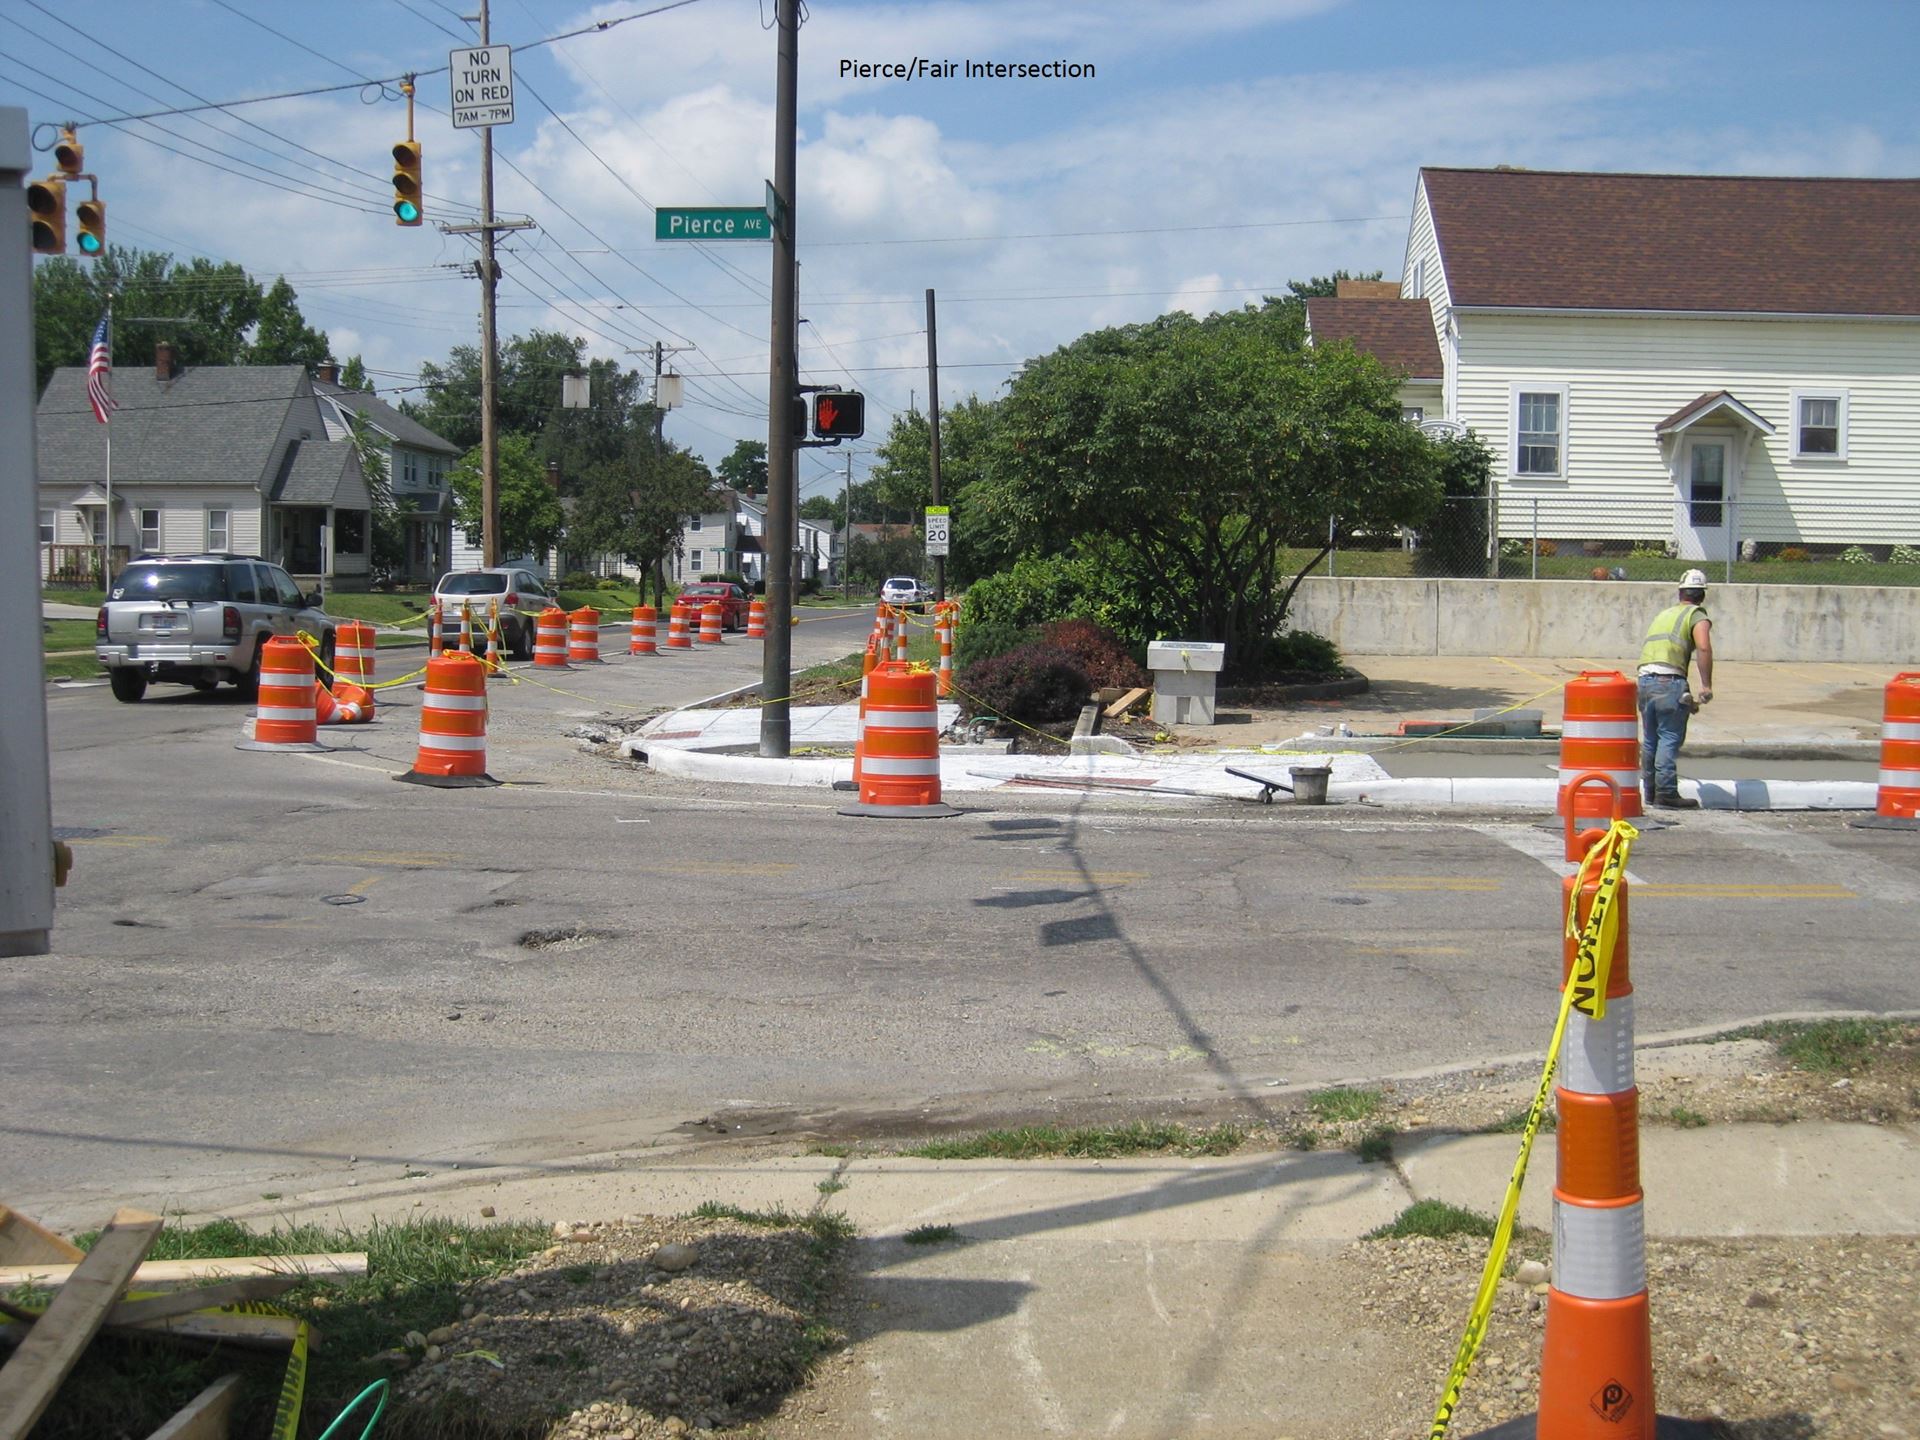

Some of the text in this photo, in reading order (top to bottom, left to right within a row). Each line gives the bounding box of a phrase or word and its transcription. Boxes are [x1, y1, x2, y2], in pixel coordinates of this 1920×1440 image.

[469, 50, 490, 66] NO
[462, 68, 501, 85] TURN
[455, 85, 509, 103] ON RED
[670, 215, 762, 234] Pierce AVE
[928, 530, 947, 541] 20
